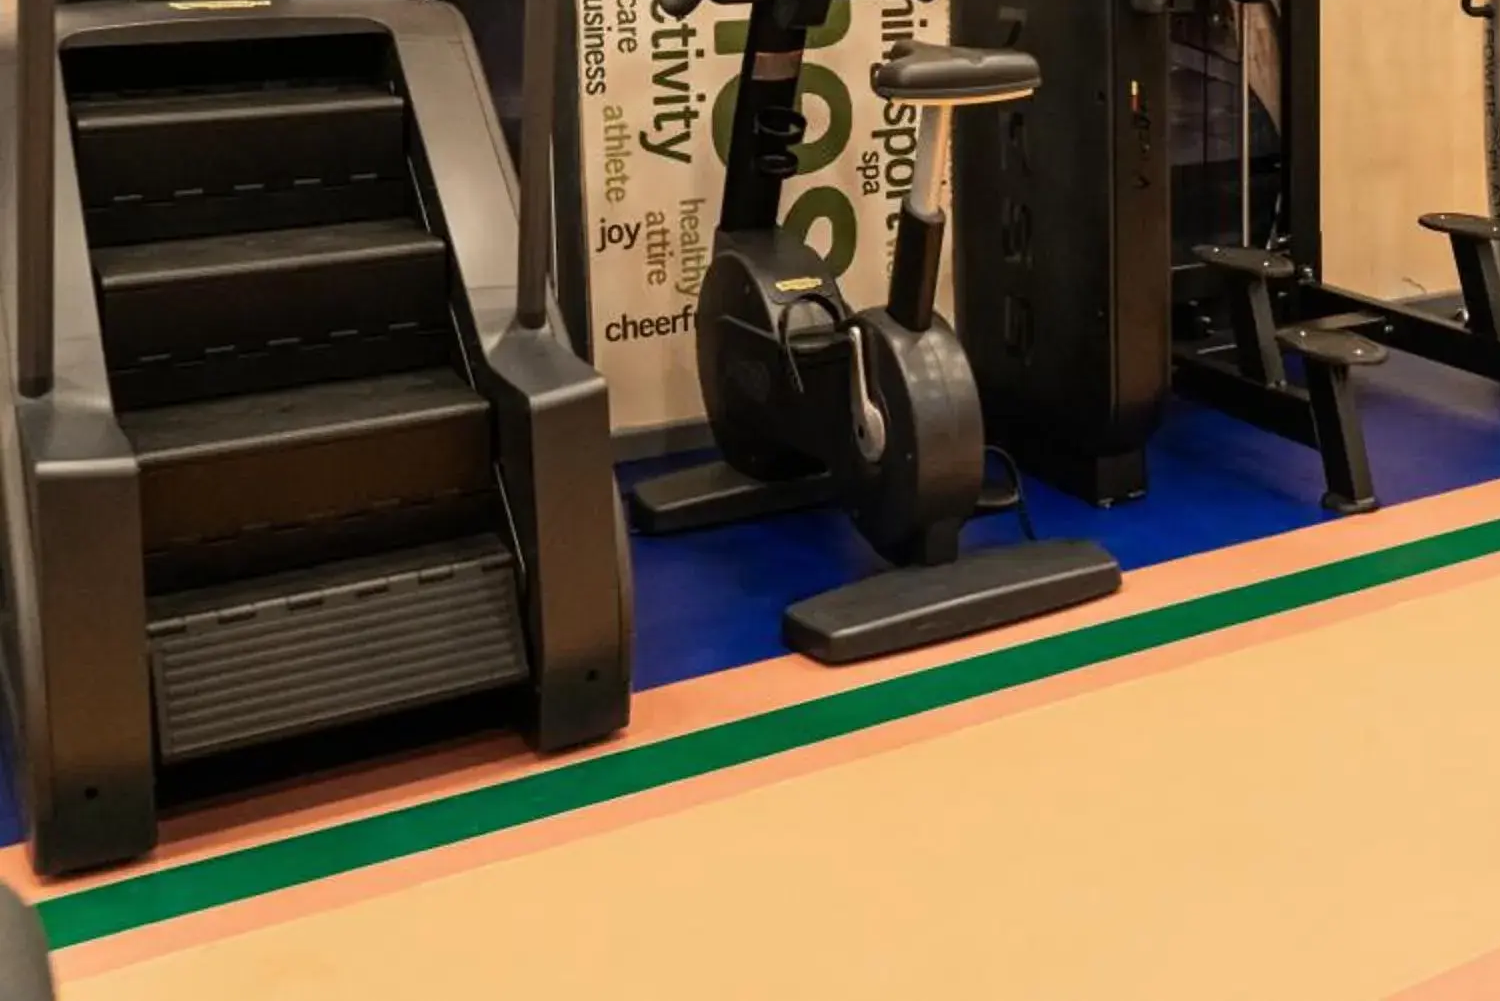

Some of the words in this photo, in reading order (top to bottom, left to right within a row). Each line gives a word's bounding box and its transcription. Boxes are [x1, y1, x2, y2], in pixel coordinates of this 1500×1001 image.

[601, 105, 632, 202] athlete
[856, 151, 881, 195] spa
[872, 102, 918, 231] sport
[596, 218, 641, 252] joy
[646, 211, 674, 286] attire
[675, 198, 707, 298] healthy
[605, 305, 696, 342] cheerf
